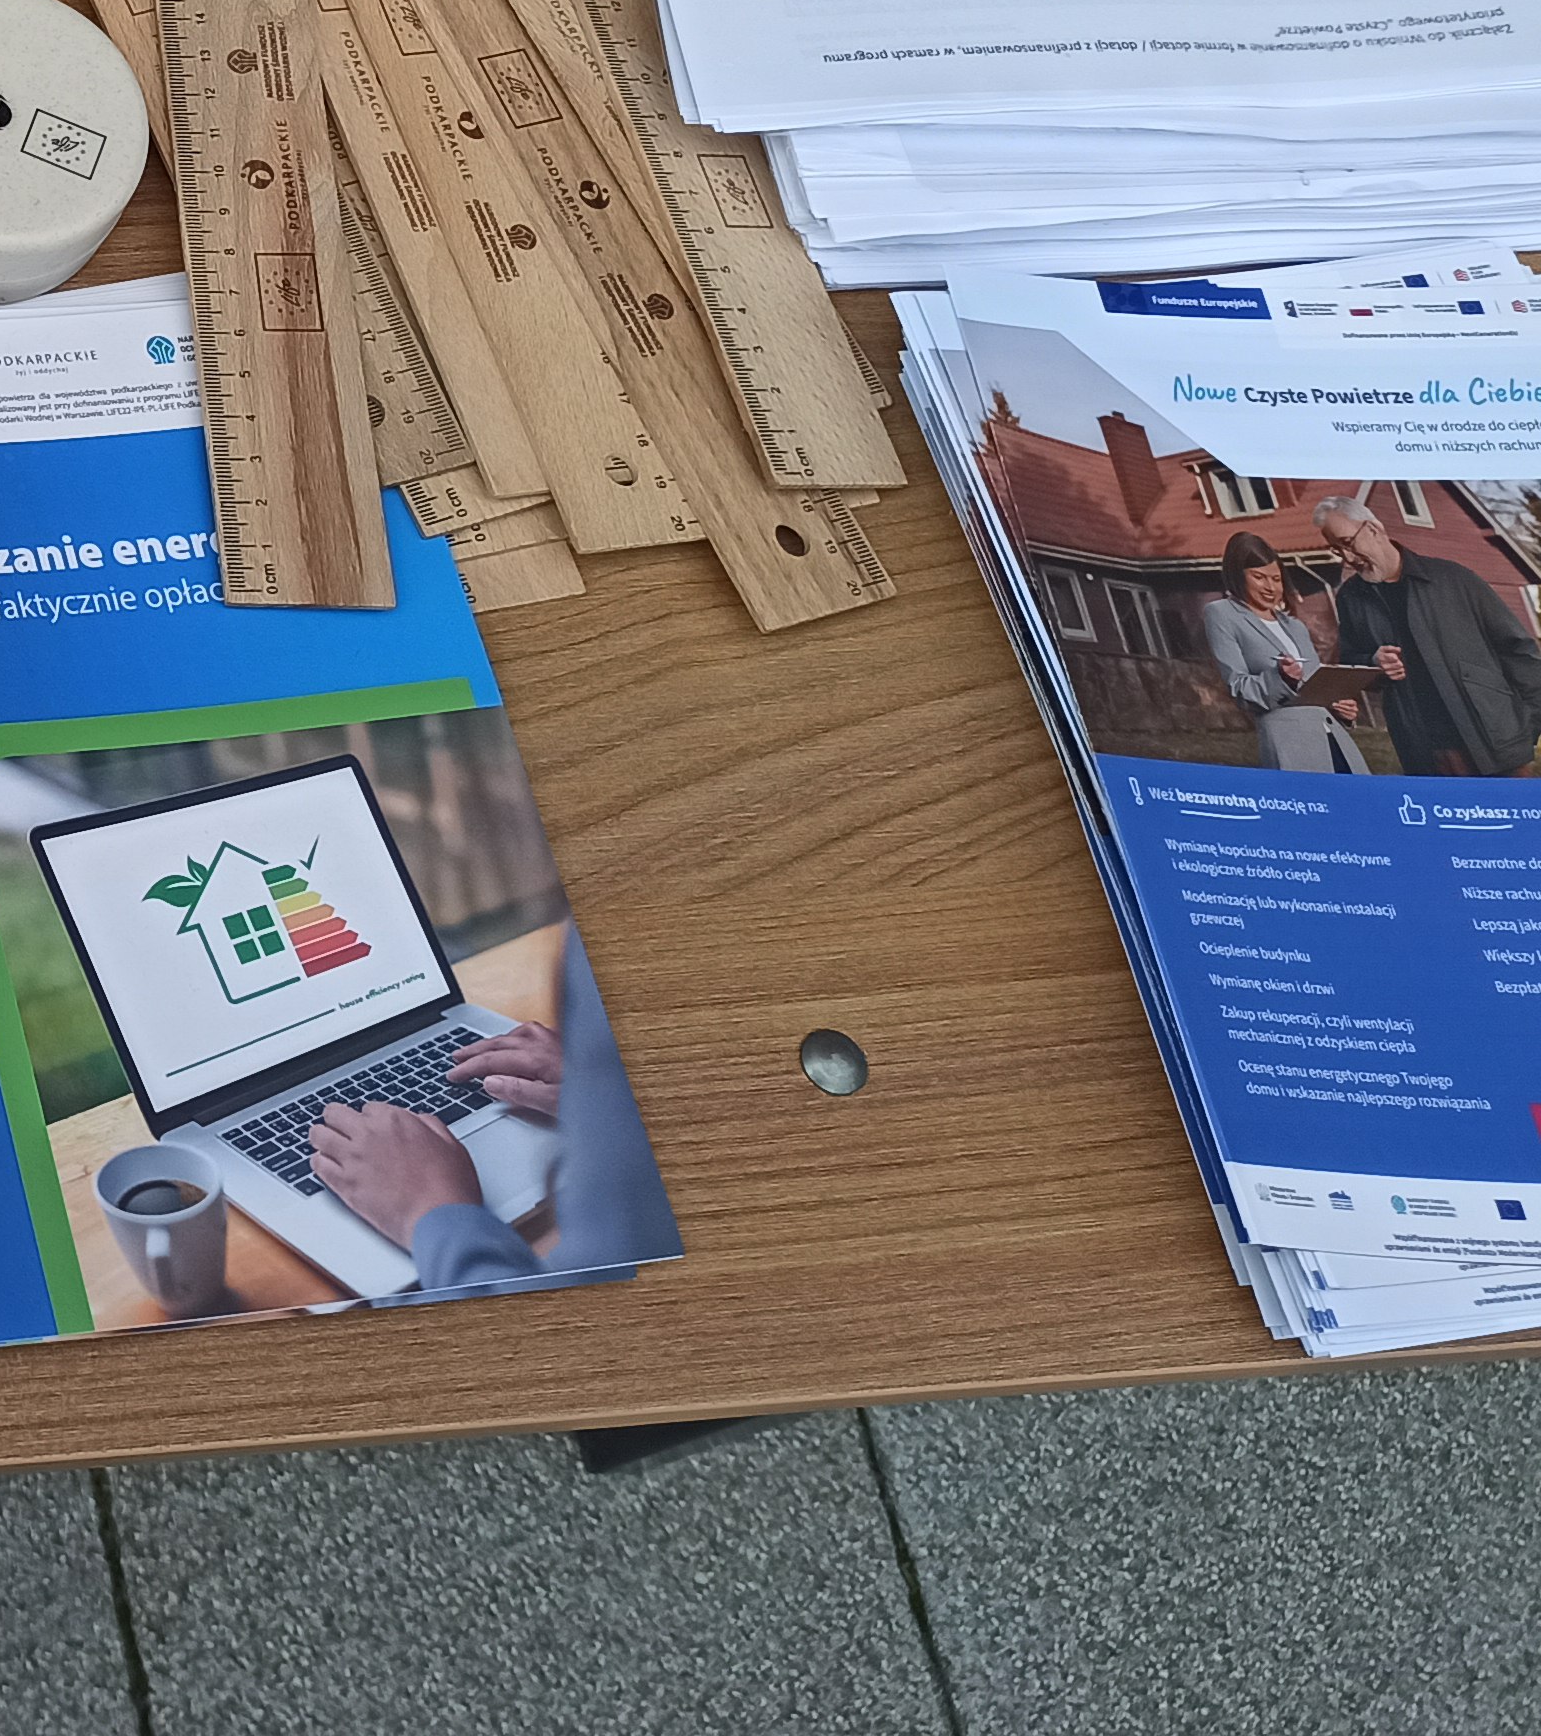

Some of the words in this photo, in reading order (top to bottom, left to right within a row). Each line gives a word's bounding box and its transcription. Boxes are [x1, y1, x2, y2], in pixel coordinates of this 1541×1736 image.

[194, 12, 206, 25] 14
[199, 49, 211, 63] 13
[204, 86, 216, 101] 12
[213, 165, 225, 179] 10
[1172, 374, 1238, 404] Nowe
[1243, 387, 1308, 406] Czyste
[1310, 387, 1414, 404] Powietrze
[1419, 380, 1460, 405] dla
[1331, 421, 1401, 434] Wspieramy
[1404, 421, 1425, 434] Cię
[1426, 423, 1438, 431] w
[1441, 420, 1485, 431] drodze
[1488, 420, 1505, 431] do
[1199, 941, 1259, 958] Ocieplenie
[1258, 946, 1311, 963] budynku
[1208, 973, 1263, 992] Wymianę
[1263, 977, 1295, 992] okien
[1295, 980, 1301, 992] i
[1302, 980, 1335, 994] drzwi
